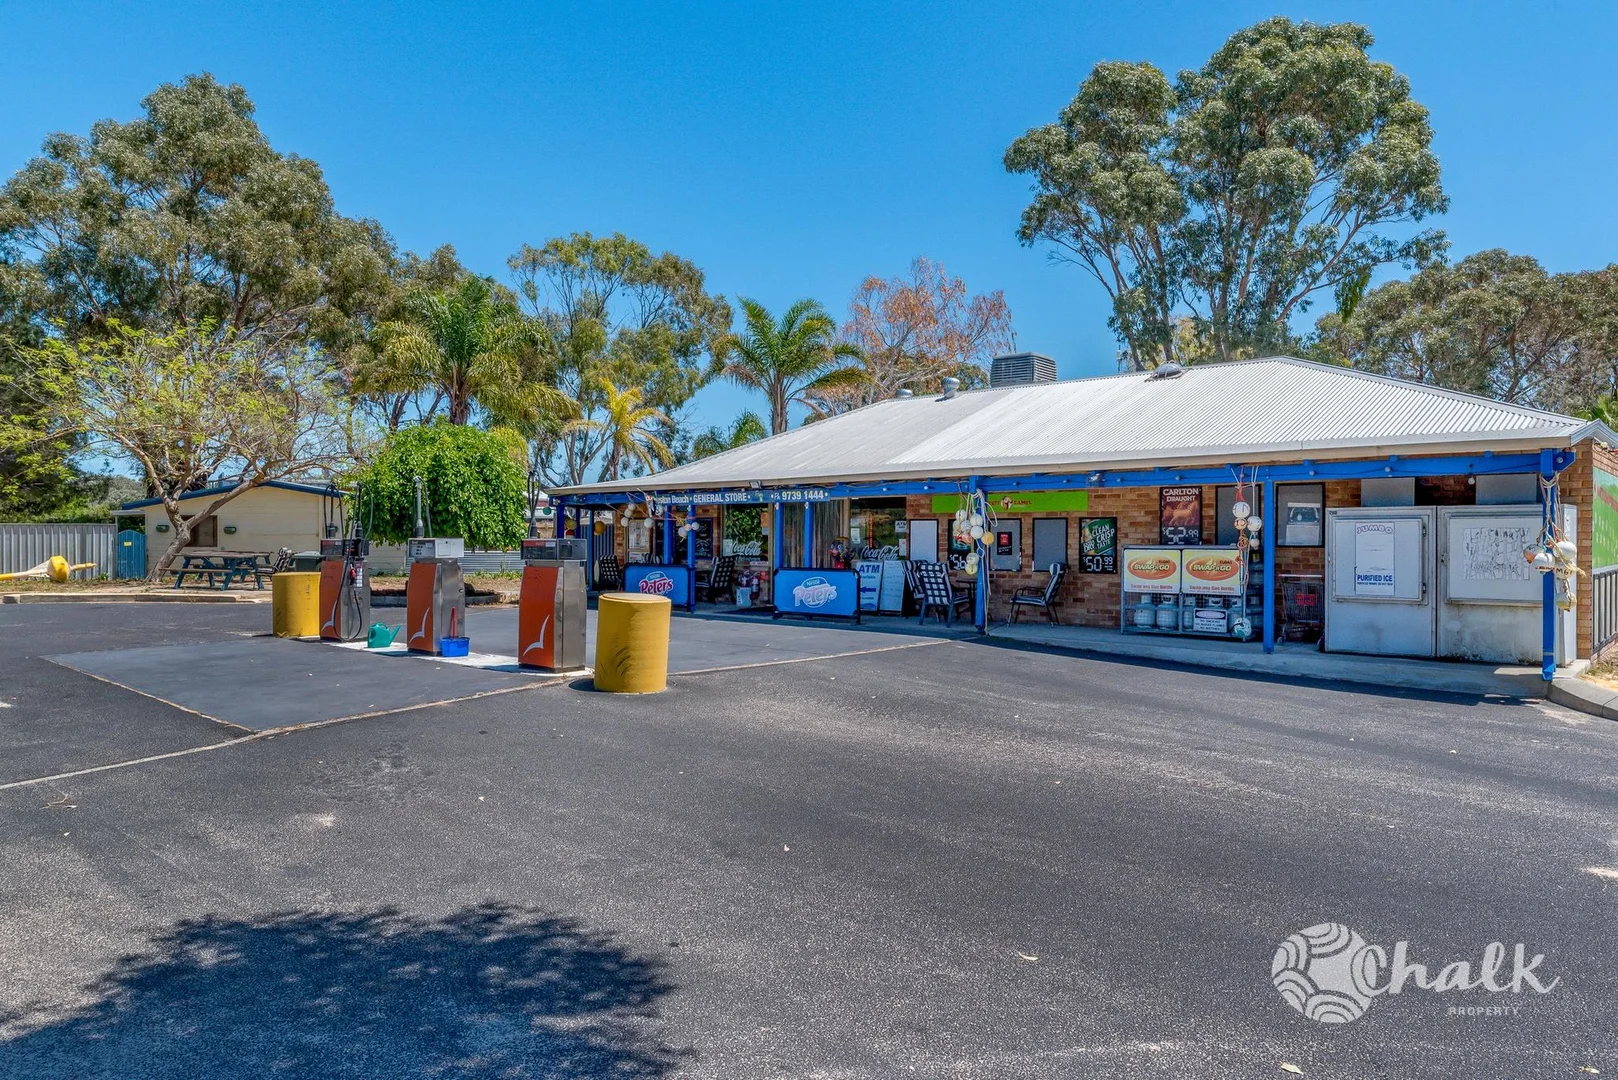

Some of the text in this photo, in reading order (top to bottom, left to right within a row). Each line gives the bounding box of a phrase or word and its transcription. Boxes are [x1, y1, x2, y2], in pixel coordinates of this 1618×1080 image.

[671, 495, 690, 504] Beach
[693, 493, 723, 503] GENERAL
[725, 492, 747, 502] STORE
[781, 491, 801, 501] 9739
[803, 490, 824, 500] 1444
[1163, 488, 1199, 496] CARLTON
[1092, 523, 1110, 537] CLEAN
[1357, 524, 1394, 535] JUMBO
[1096, 528, 1115, 543] CRISP
[1096, 539, 1111, 550] TASTE
[859, 565, 880, 573] ATM
[1133, 563, 1155, 571] SWAP
[1192, 563, 1215, 571] SWAP
[1220, 564, 1232, 572] GO
[1357, 574, 1393, 582] PURIFIED ICE
[639, 578, 673, 594] Peters
[793, 585, 838, 606] Peters
